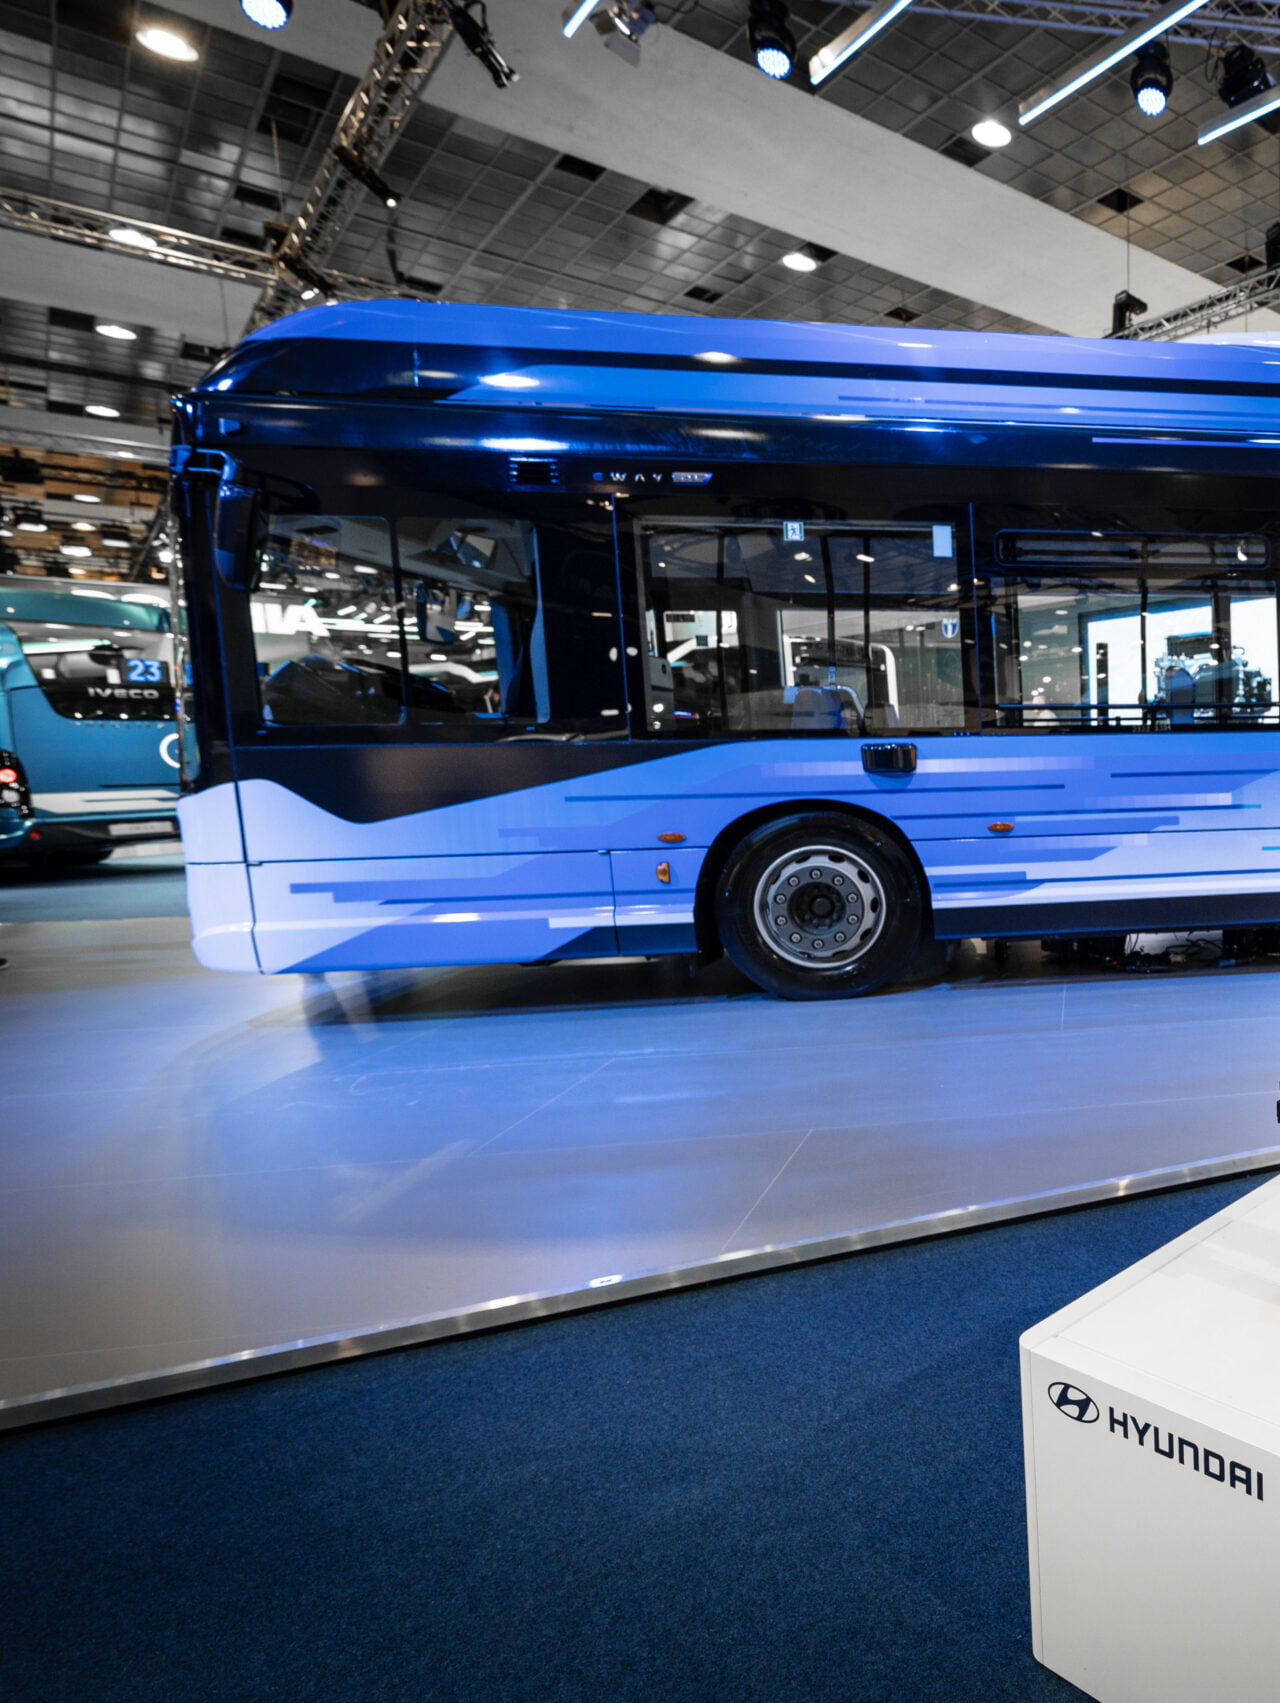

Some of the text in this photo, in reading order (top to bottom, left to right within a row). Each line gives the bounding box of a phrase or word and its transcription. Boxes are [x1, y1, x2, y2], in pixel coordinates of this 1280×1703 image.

[128, 659, 161, 682] 23
[87, 687, 159, 699] IVECO
[1108, 1406, 1264, 1501] HYUNDAI
